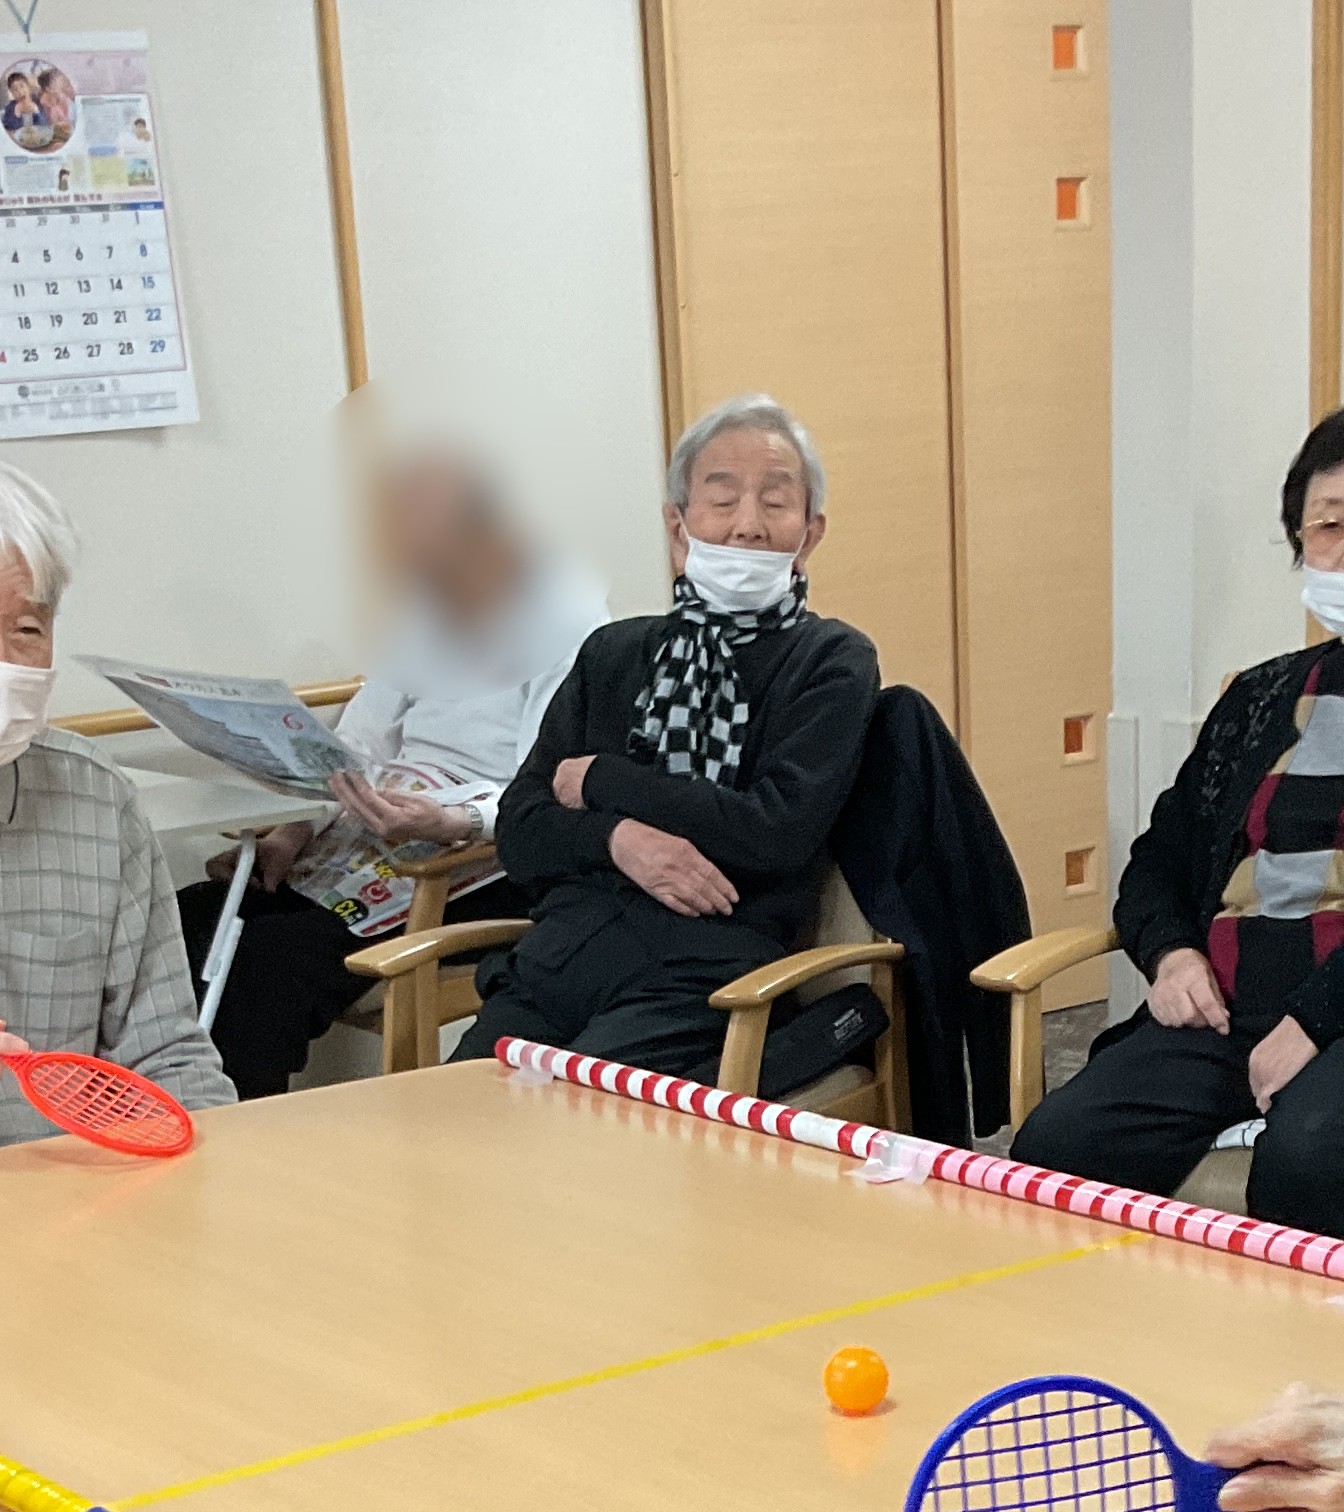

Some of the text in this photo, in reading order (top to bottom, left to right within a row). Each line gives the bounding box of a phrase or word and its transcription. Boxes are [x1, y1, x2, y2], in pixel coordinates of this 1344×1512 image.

[11, 250, 19, 263] 4
[43, 249, 51, 263] 5
[76, 246, 83, 261] 6
[106, 245, 113, 259] 7
[140, 243, 148, 258] 8
[13, 283, 25, 297] 11
[45, 282, 59, 295] 12
[77, 279, 91, 293] 13
[109, 278, 123, 291] 14
[141, 276, 155, 289] 15
[18, 316, 31, 330] 18
[50, 314, 63, 328] 19
[82, 312, 98, 325] 20
[114, 310, 127, 324] 21
[145, 307, 161, 321] 22
[22, 348, 39, 362] 25
[54, 346, 70, 360] 26
[86, 344, 101, 358] 27
[118, 342, 134, 355] 28
[150, 339, 166, 353] 29
